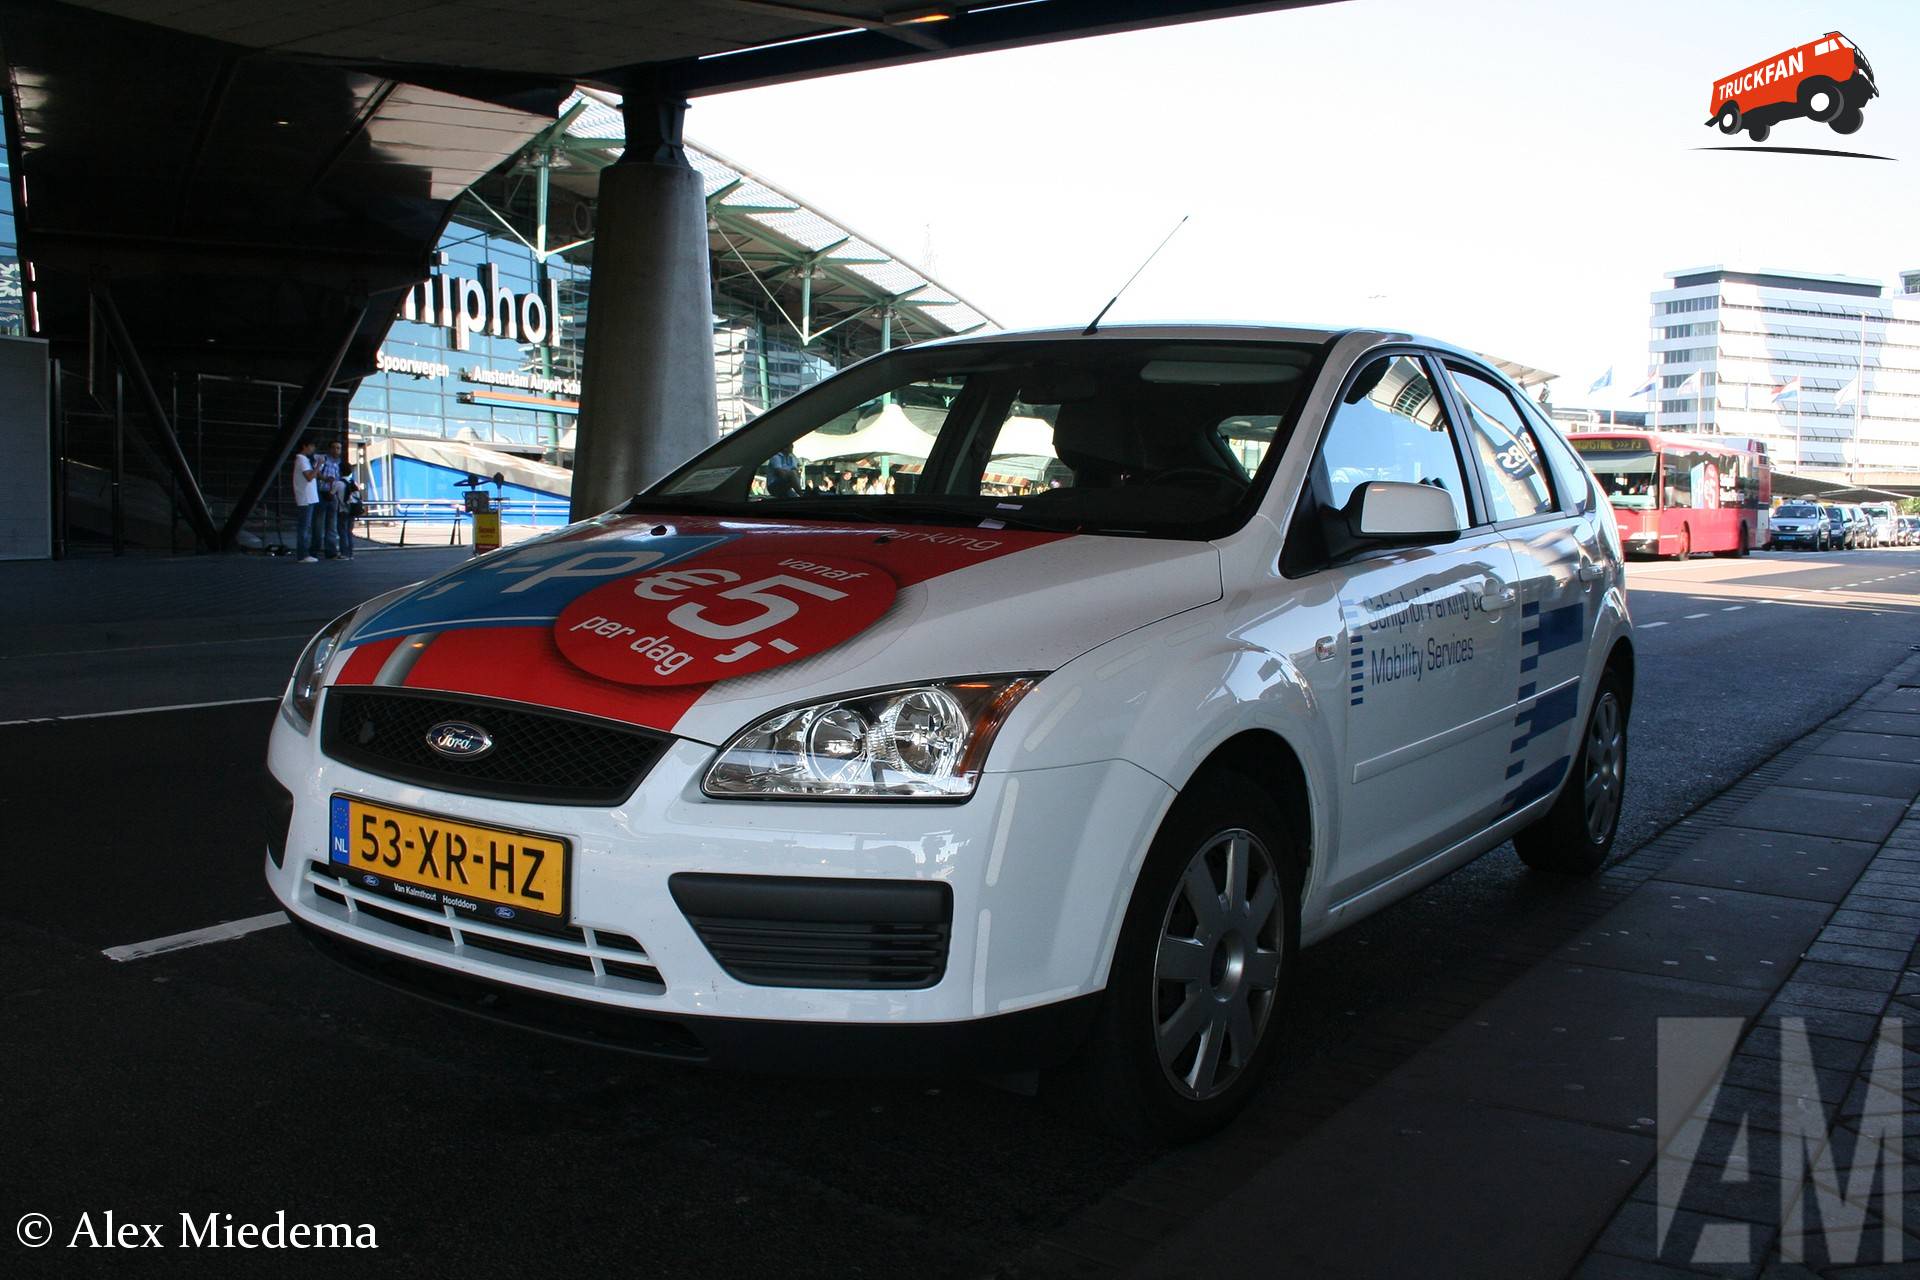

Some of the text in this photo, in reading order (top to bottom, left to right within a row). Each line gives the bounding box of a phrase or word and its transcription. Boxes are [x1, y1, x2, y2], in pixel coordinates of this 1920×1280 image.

[376, 350, 449, 380] Spoorwegen
[473, 366, 529, 387] Amsterdam
[529, 374, 562, 393] Airport
[778, 555, 869, 584] vanaf
[569, 611, 695, 678] per dag
[1371, 634, 1473, 686] Mobility Services
[437, 727, 473, 750] Ford
[334, 837, 348, 853] NL
[361, 813, 545, 901] 53-XR-HZ
[393, 882, 405, 894] Van
[442, 895, 477, 912] Hoofddorp
